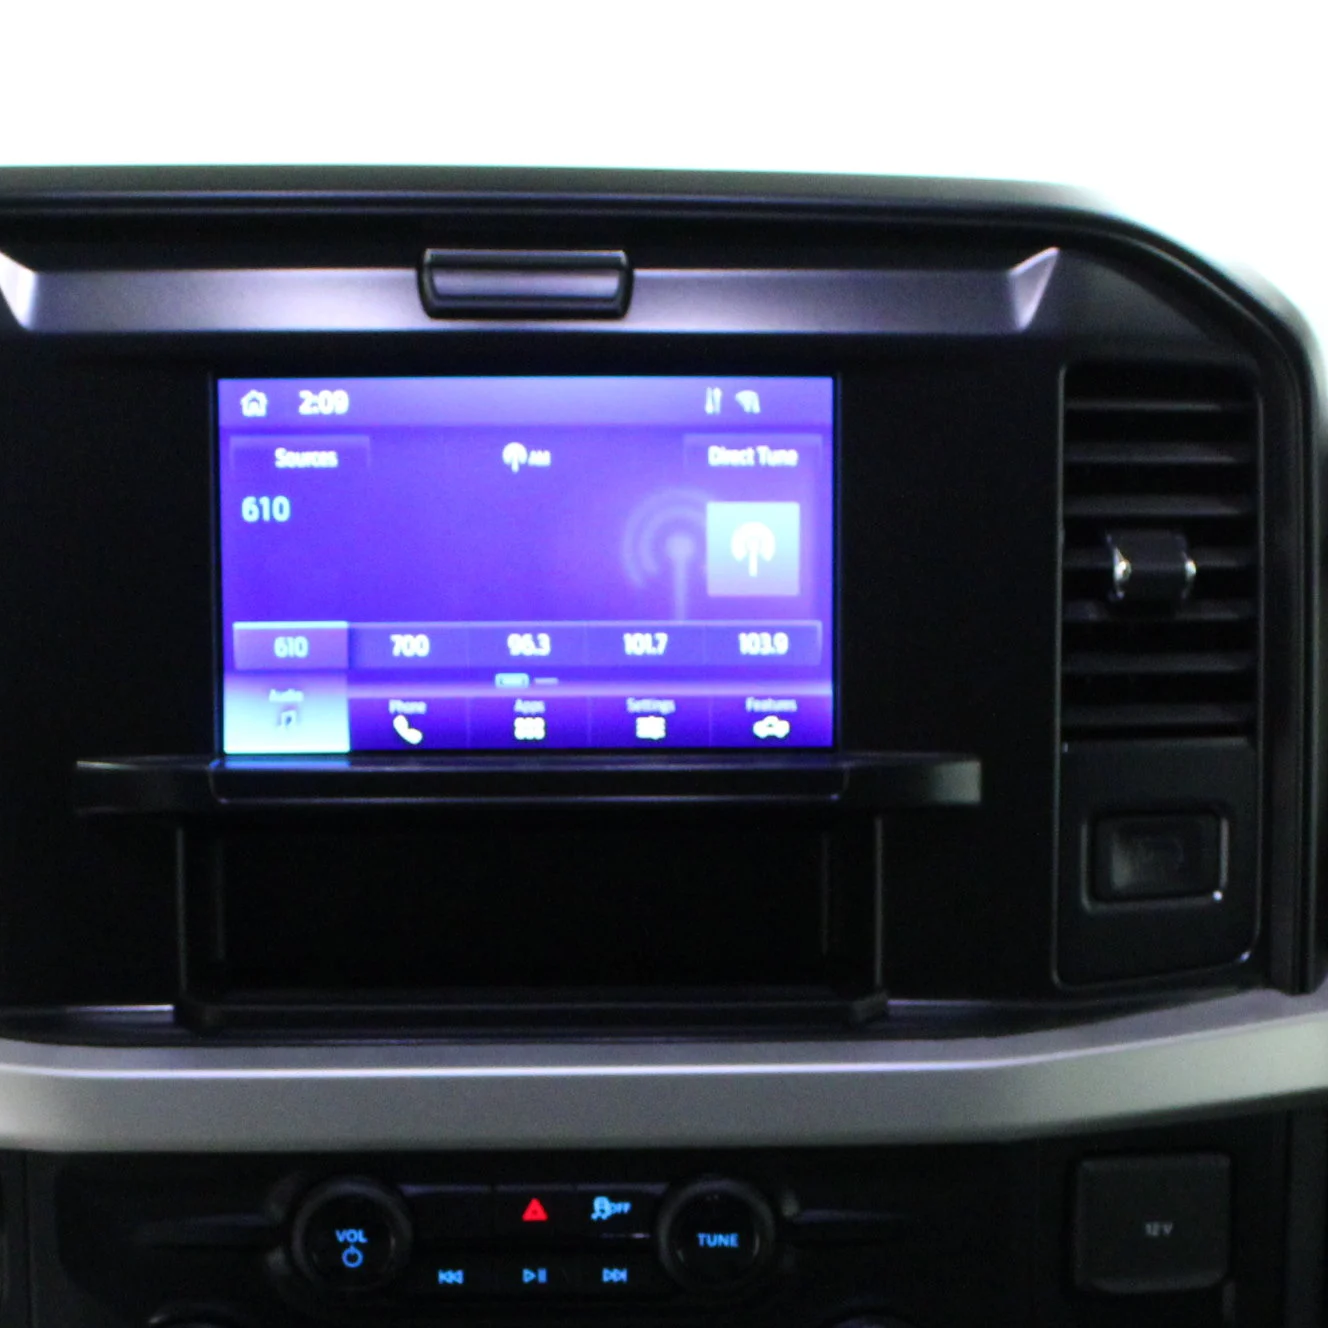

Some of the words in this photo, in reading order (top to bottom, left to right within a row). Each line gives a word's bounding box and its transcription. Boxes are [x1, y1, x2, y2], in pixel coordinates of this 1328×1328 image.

[298, 389, 349, 415] 2:09
[274, 446, 339, 468] Sources
[708, 445, 755, 467] Direct
[756, 445, 799, 467] Tune
[241, 495, 291, 522] 610
[273, 635, 309, 658] 610
[389, 633, 430, 657] 700
[507, 633, 551, 656] 96.3
[623, 632, 668, 655] 101.7
[738, 632, 789, 655] 103.9
[389, 699, 427, 714] Phone
[626, 697, 676, 715] Settings
[745, 696, 797, 713] Features
[335, 1229, 369, 1243] VOL
[697, 1232, 739, 1248] TUNE
